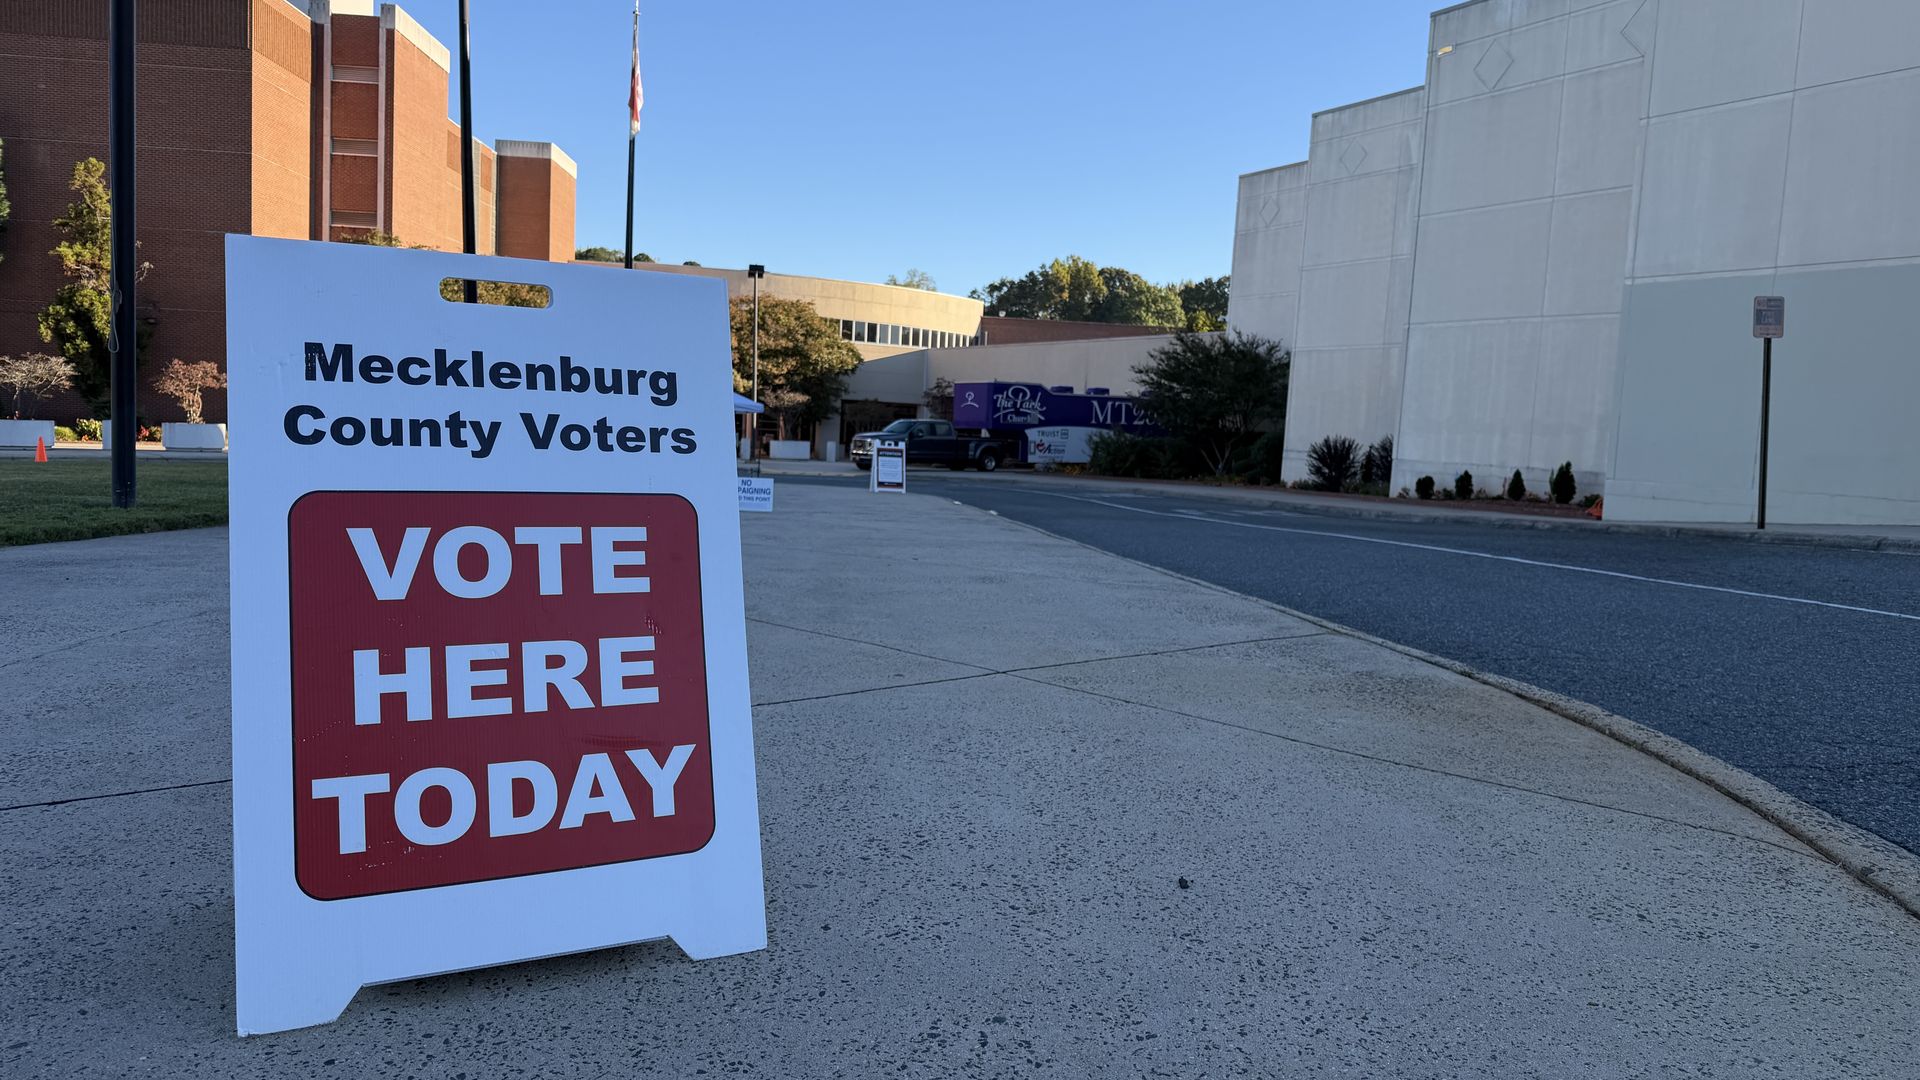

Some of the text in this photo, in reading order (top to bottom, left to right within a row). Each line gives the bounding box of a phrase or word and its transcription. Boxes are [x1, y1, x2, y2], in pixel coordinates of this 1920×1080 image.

[304, 342, 678, 407] Mecklenburg
[1008, 385, 1047, 411] Park
[284, 405, 698, 458] County Voters
[741, 479, 752, 487] NO
[346, 526, 650, 600] VOTE
[353, 636, 659, 725] HERE
[311, 743, 697, 854] TODAY
